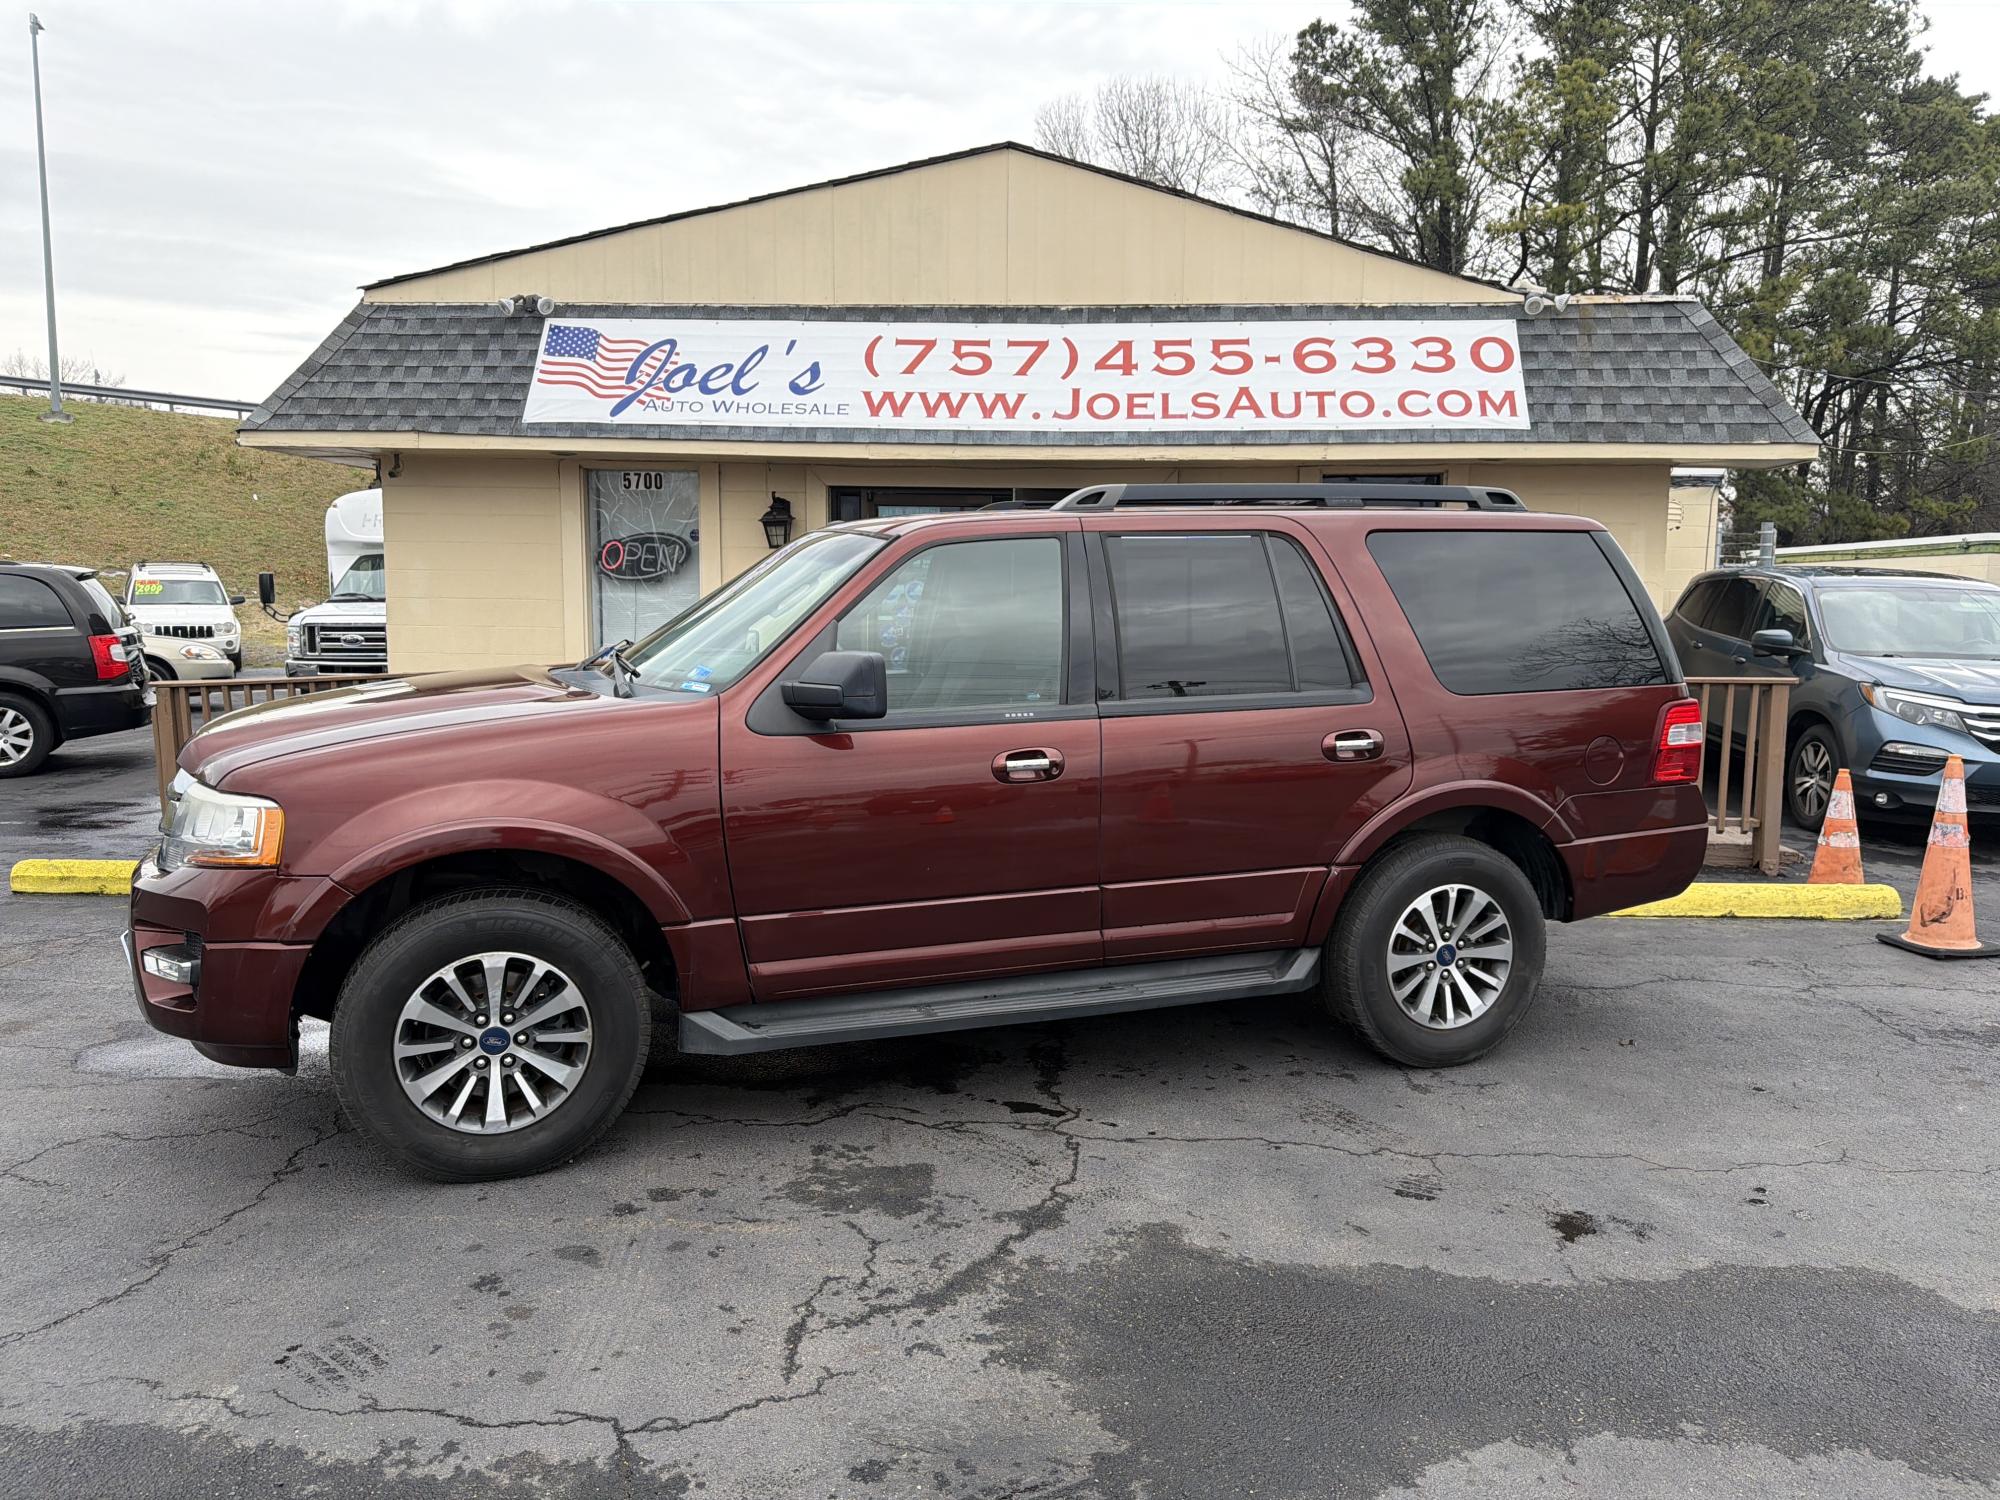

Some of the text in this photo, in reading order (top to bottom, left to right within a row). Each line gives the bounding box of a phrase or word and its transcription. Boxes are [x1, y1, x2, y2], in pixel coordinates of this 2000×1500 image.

[864, 335, 1515, 380] (757)455-6330
[609, 338, 825, 417] Joel's
[623, 472, 663, 490] 5700
[602, 541, 679, 571] OPEN
